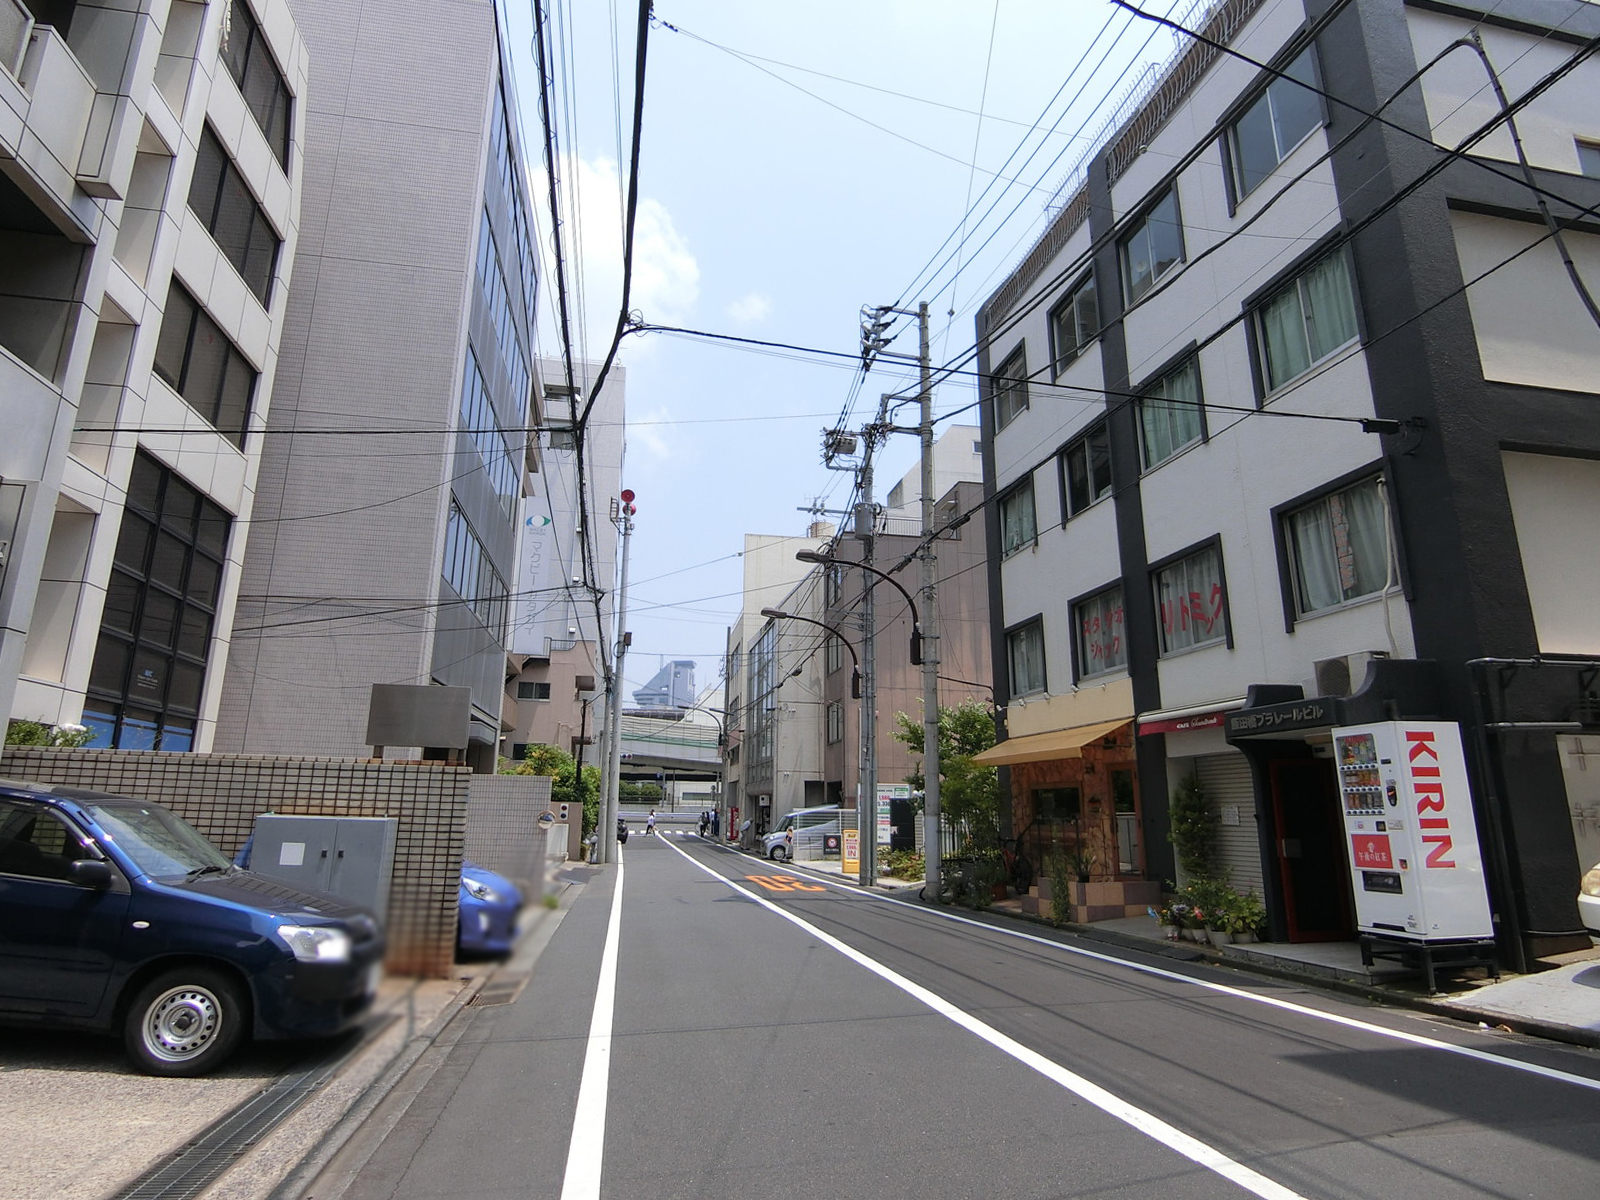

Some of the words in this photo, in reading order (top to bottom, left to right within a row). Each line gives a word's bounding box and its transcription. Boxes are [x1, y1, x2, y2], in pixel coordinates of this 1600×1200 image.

[1161, 583, 1223, 635] リトミック
[1405, 731, 1456, 868] KIRIN
